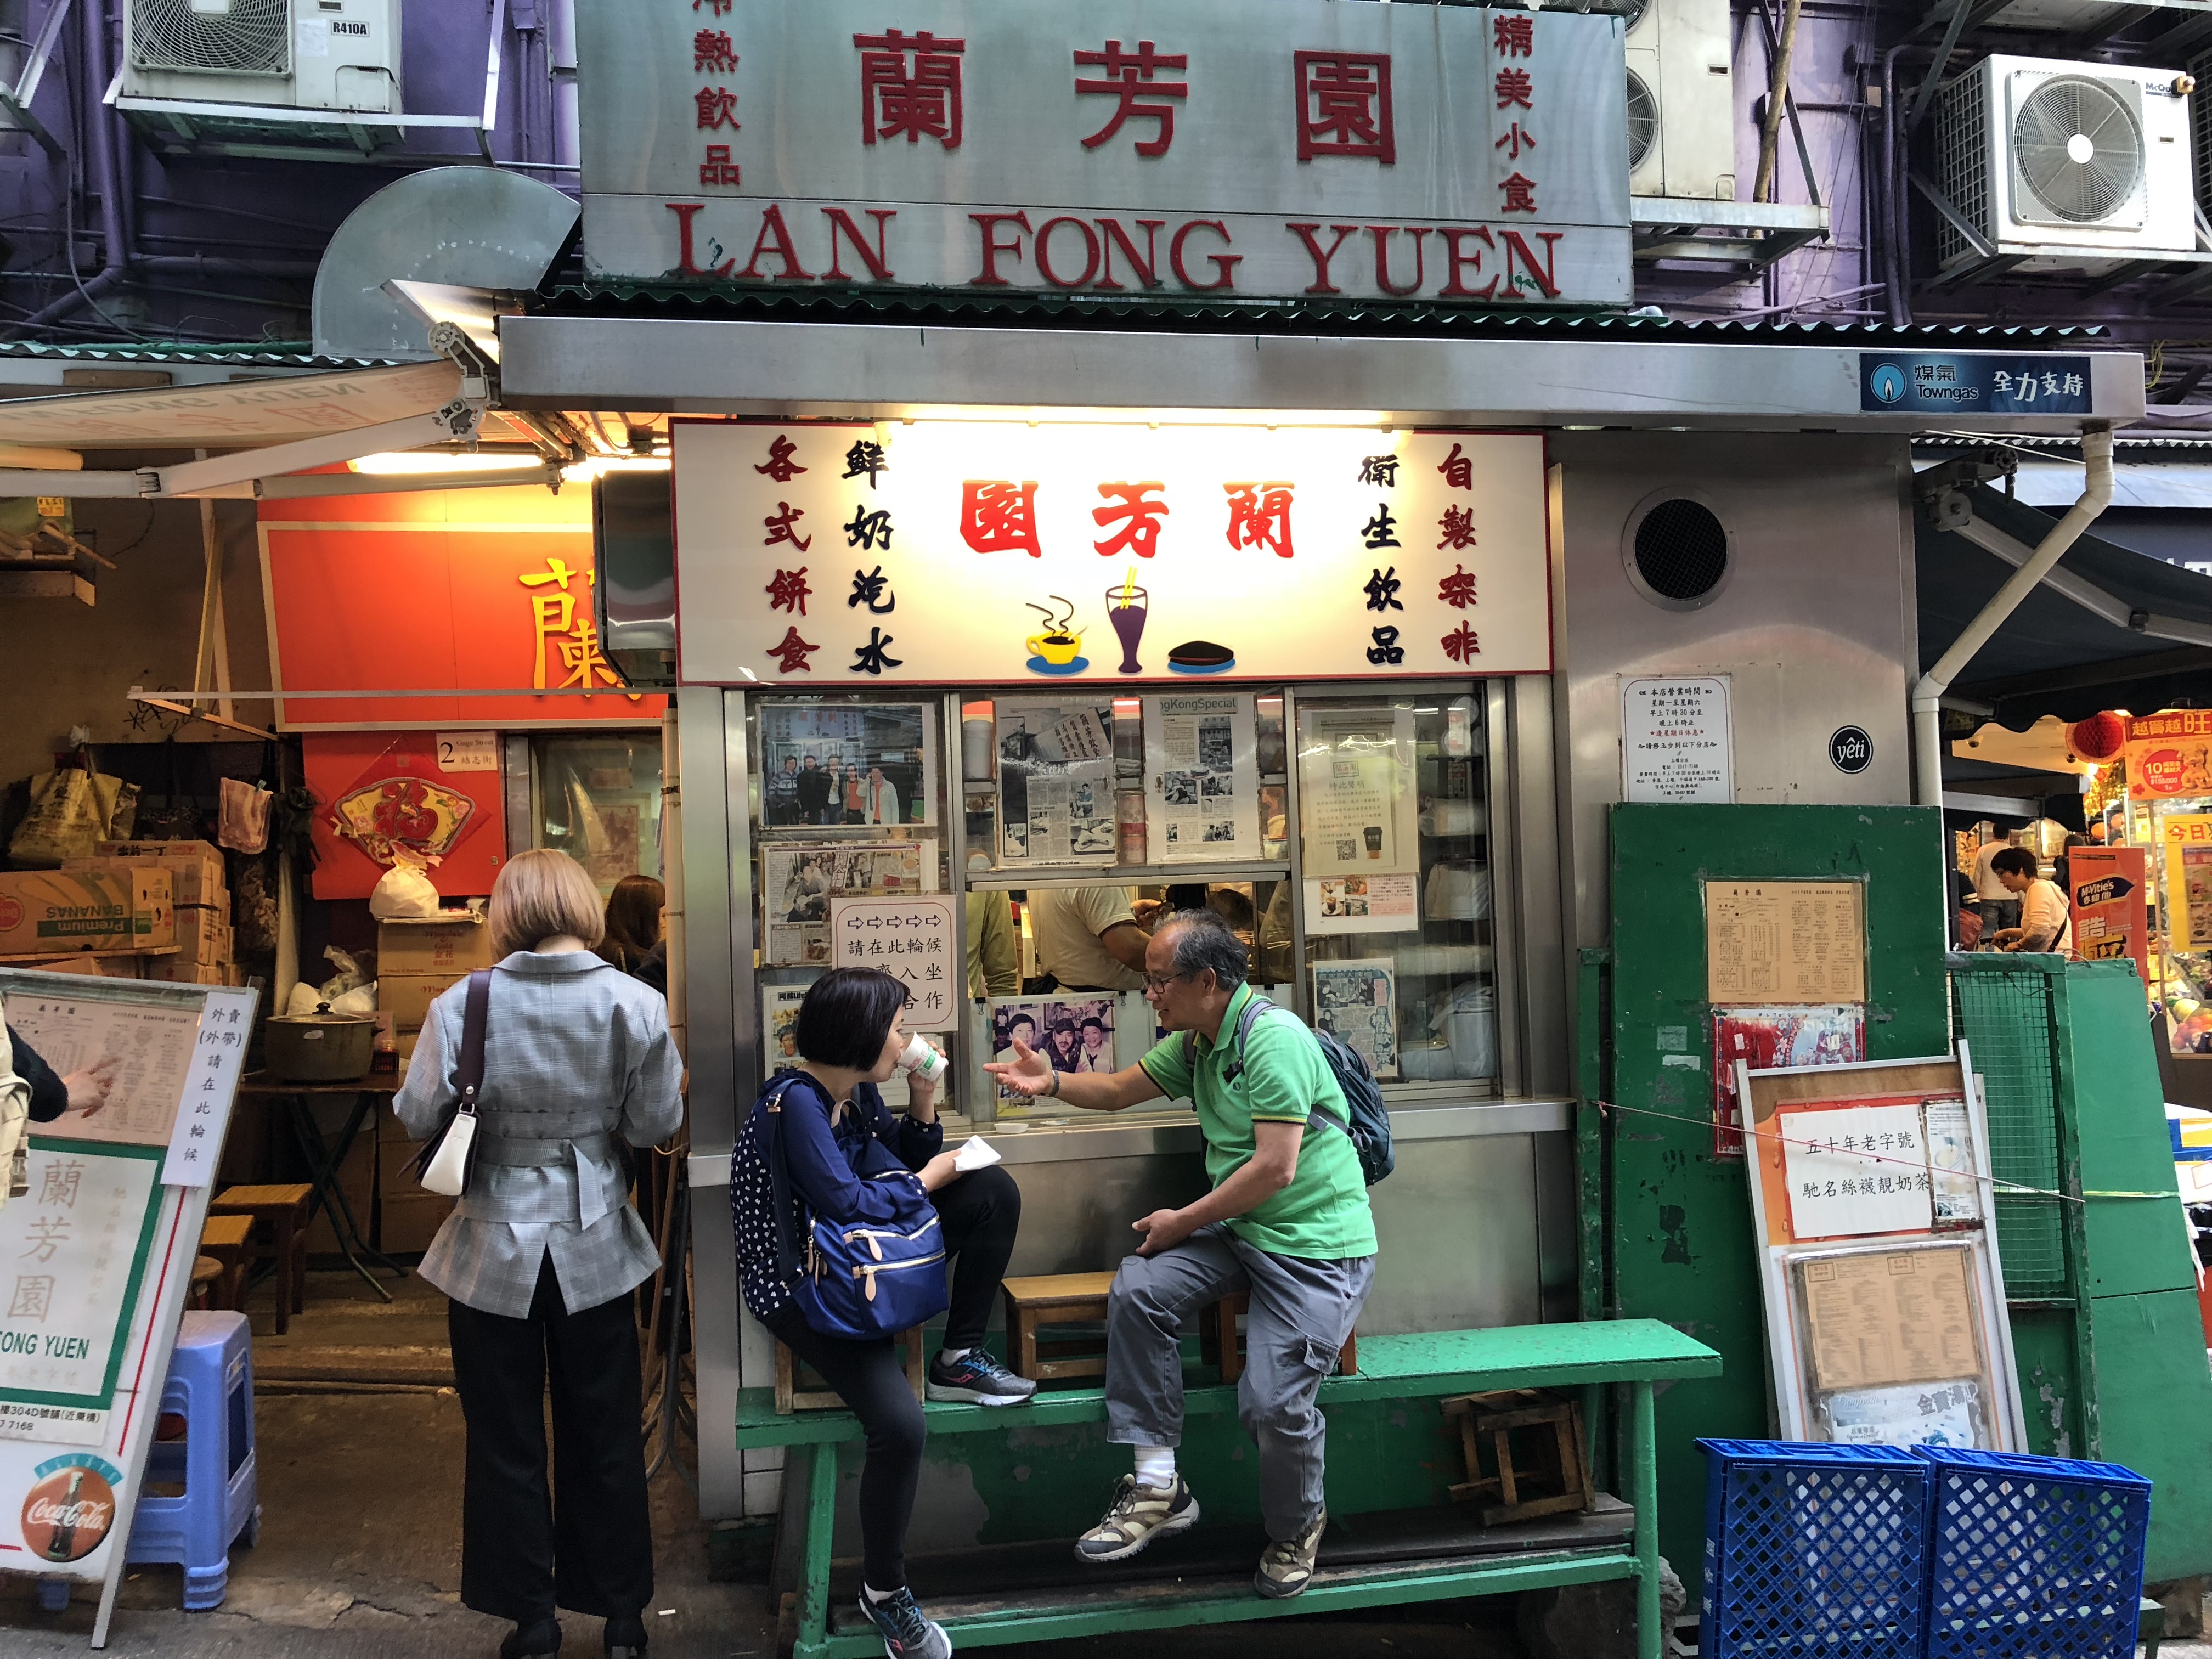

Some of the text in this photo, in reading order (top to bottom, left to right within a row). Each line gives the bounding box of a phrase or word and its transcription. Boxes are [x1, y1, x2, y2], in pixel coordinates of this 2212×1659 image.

[332, 22, 367, 35] R410A
[854, 28, 1395, 164] 蘭芳園
[2146, 82, 2171, 92] McQu
[1494, 14, 1538, 213] 精美小食
[665, 203, 1564, 302] LAN FONG YUEN
[1914, 364, 2083, 402] 煤氣 全力支持
[1915, 384, 1979, 402] Towngas
[754, 434, 821, 674] 各式餅食
[842, 439, 904, 674] 鮮奶汽水
[1357, 454, 1406, 667] 衛生飲品
[1651, 687, 1701, 696] 本店營業時間
[2132, 712, 2211, 736] 越買越旺
[439, 742, 455, 764] 2
[461, 754, 492, 765] 結志街
[2145, 762, 2162, 775] 10
[2168, 824, 2205, 841] 今日
[46, 904, 124, 918] BANANAS
[58, 919, 125, 932] Premium
[847, 937, 943, 957] 請在此輪候
[1805, 1131, 1915, 1154] 五十年老字號
[1803, 1172, 1931, 1198] 馳名絲襪靚奶茶
[7, 1158, 86, 1324] 蘭芳園
[0, 1330, 90, 1360] ONG YUEN
